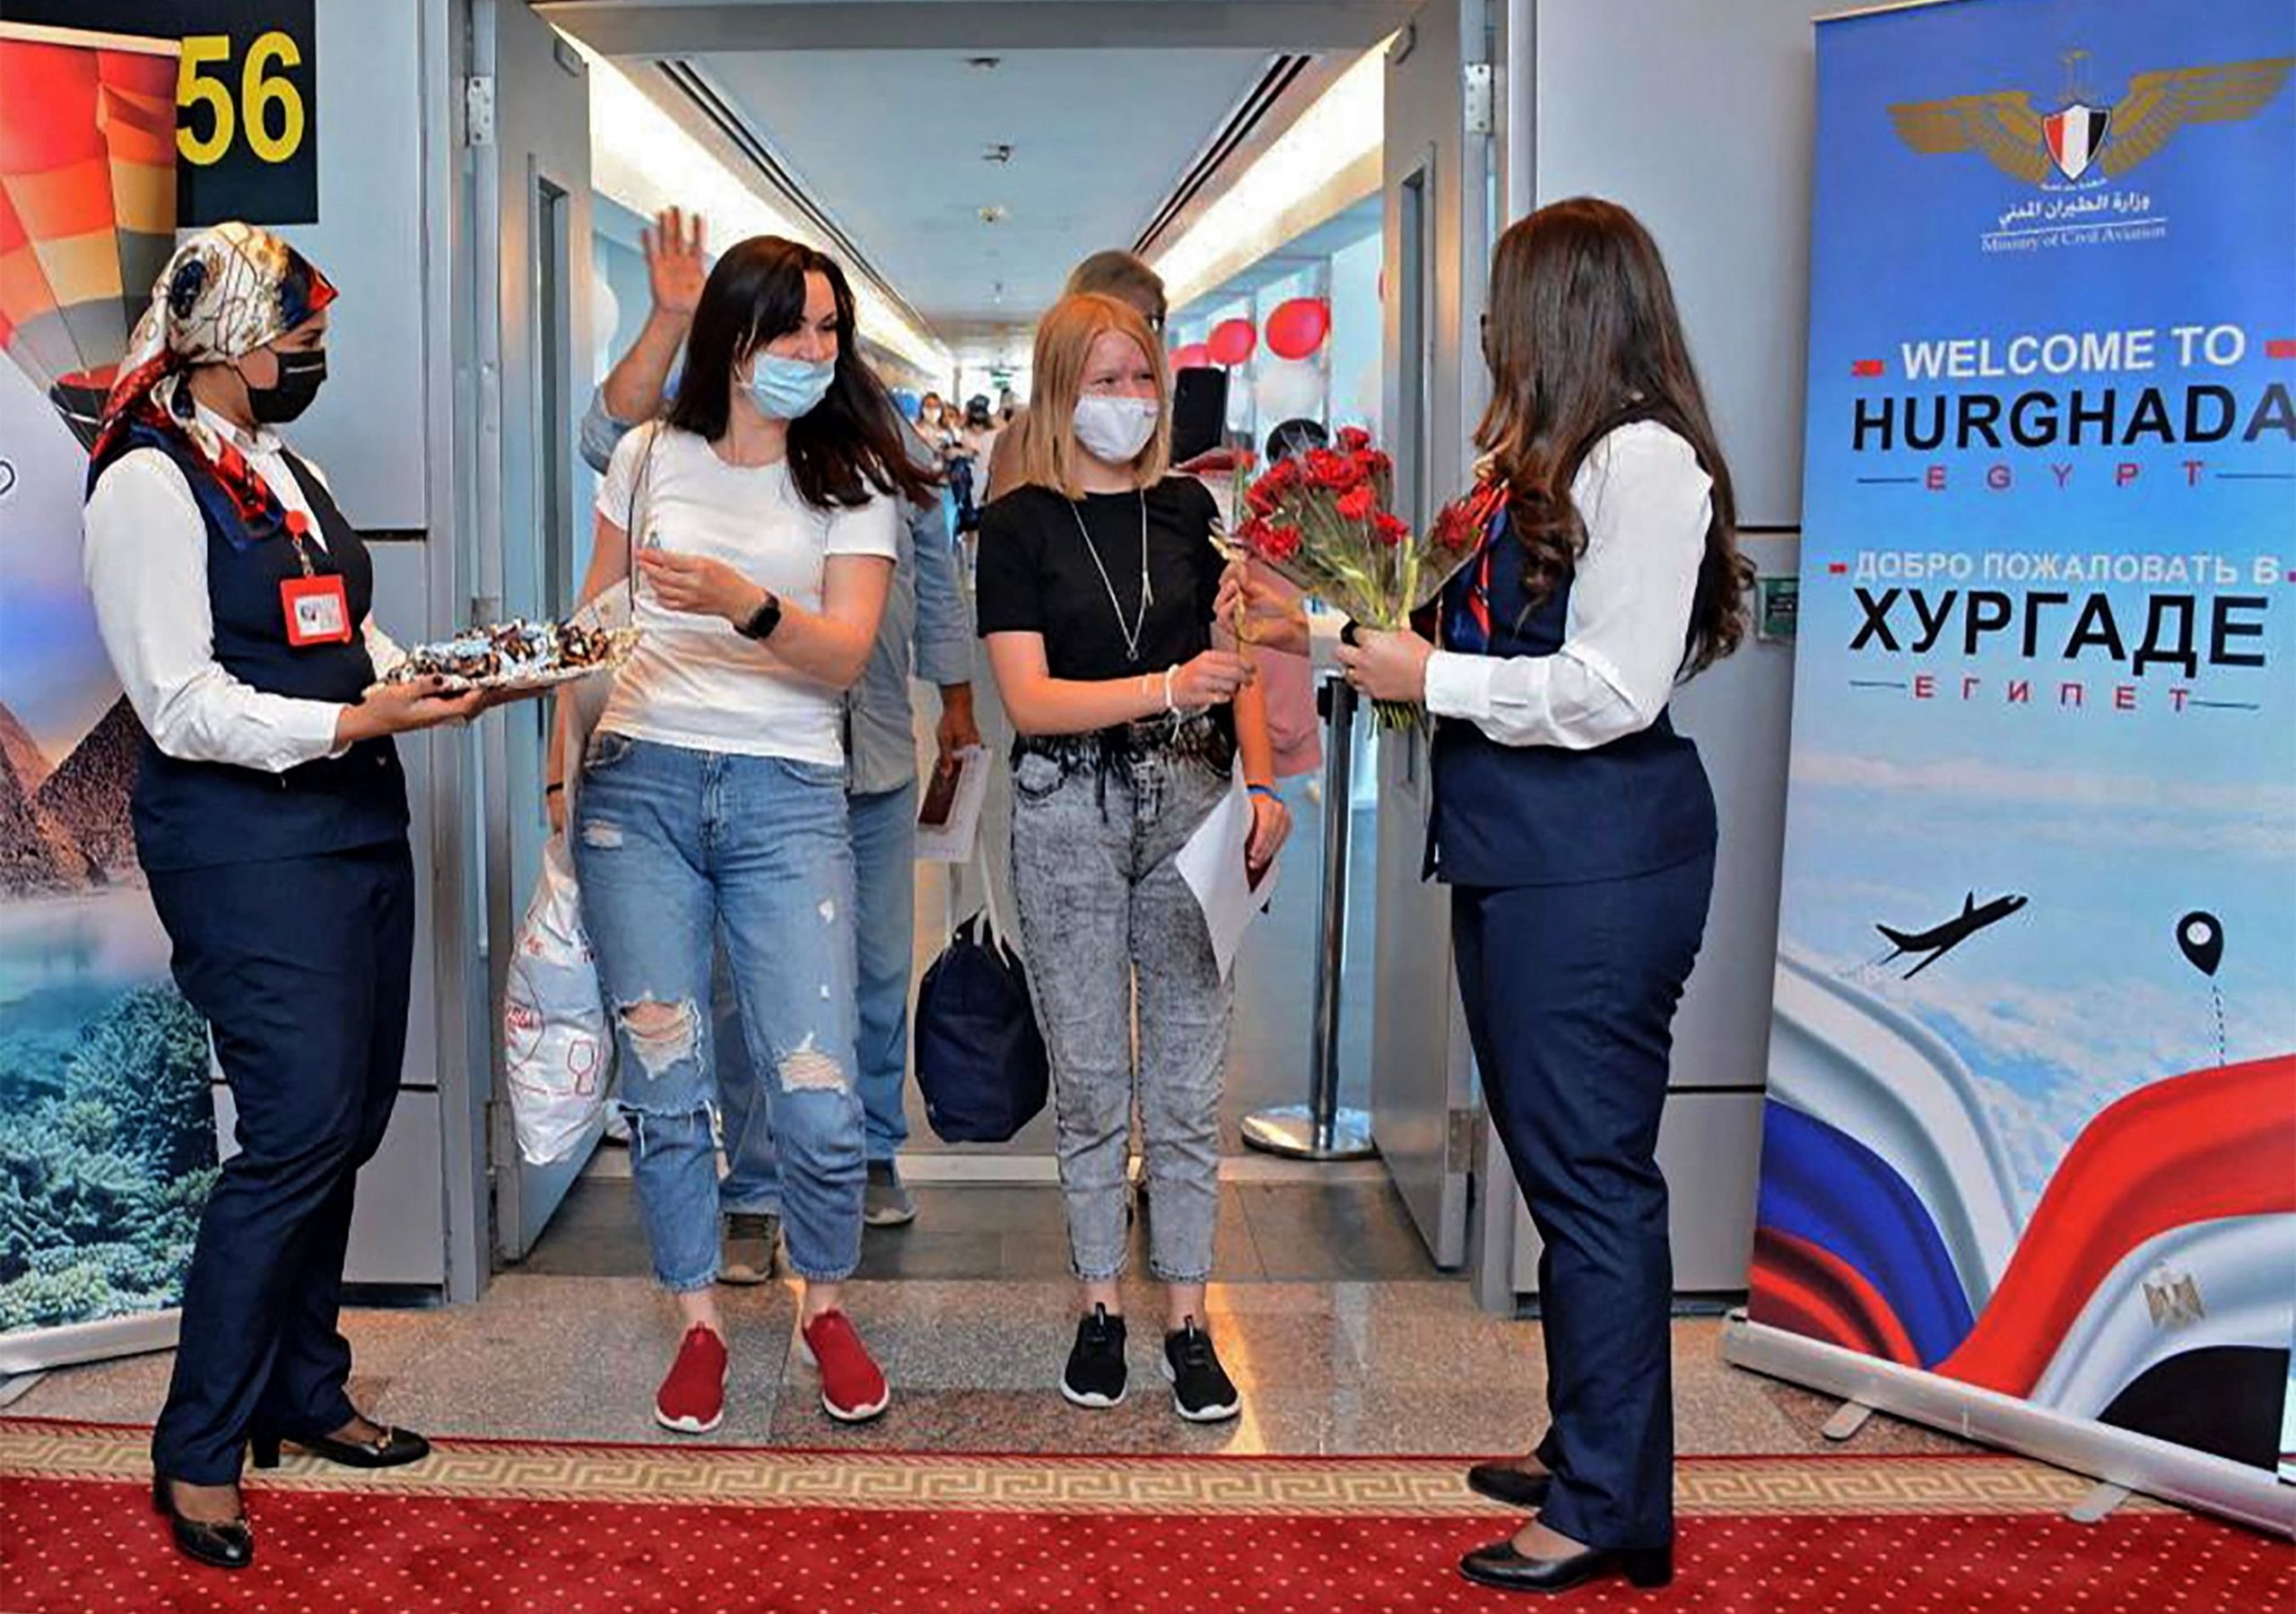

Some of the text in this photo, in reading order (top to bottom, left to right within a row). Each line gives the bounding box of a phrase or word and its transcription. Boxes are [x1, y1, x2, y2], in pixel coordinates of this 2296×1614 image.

[176, 30, 305, 165] 56
[1901, 325, 2245, 379] WELCOME TO
[1852, 383, 2296, 450] HURGHADA
[1854, 551, 1972, 581] ДОБРО
[1983, 551, 2238, 584] ПОЖАЛОВАТЬ
[1848, 587, 2269, 680] ХУРГАДЕ
